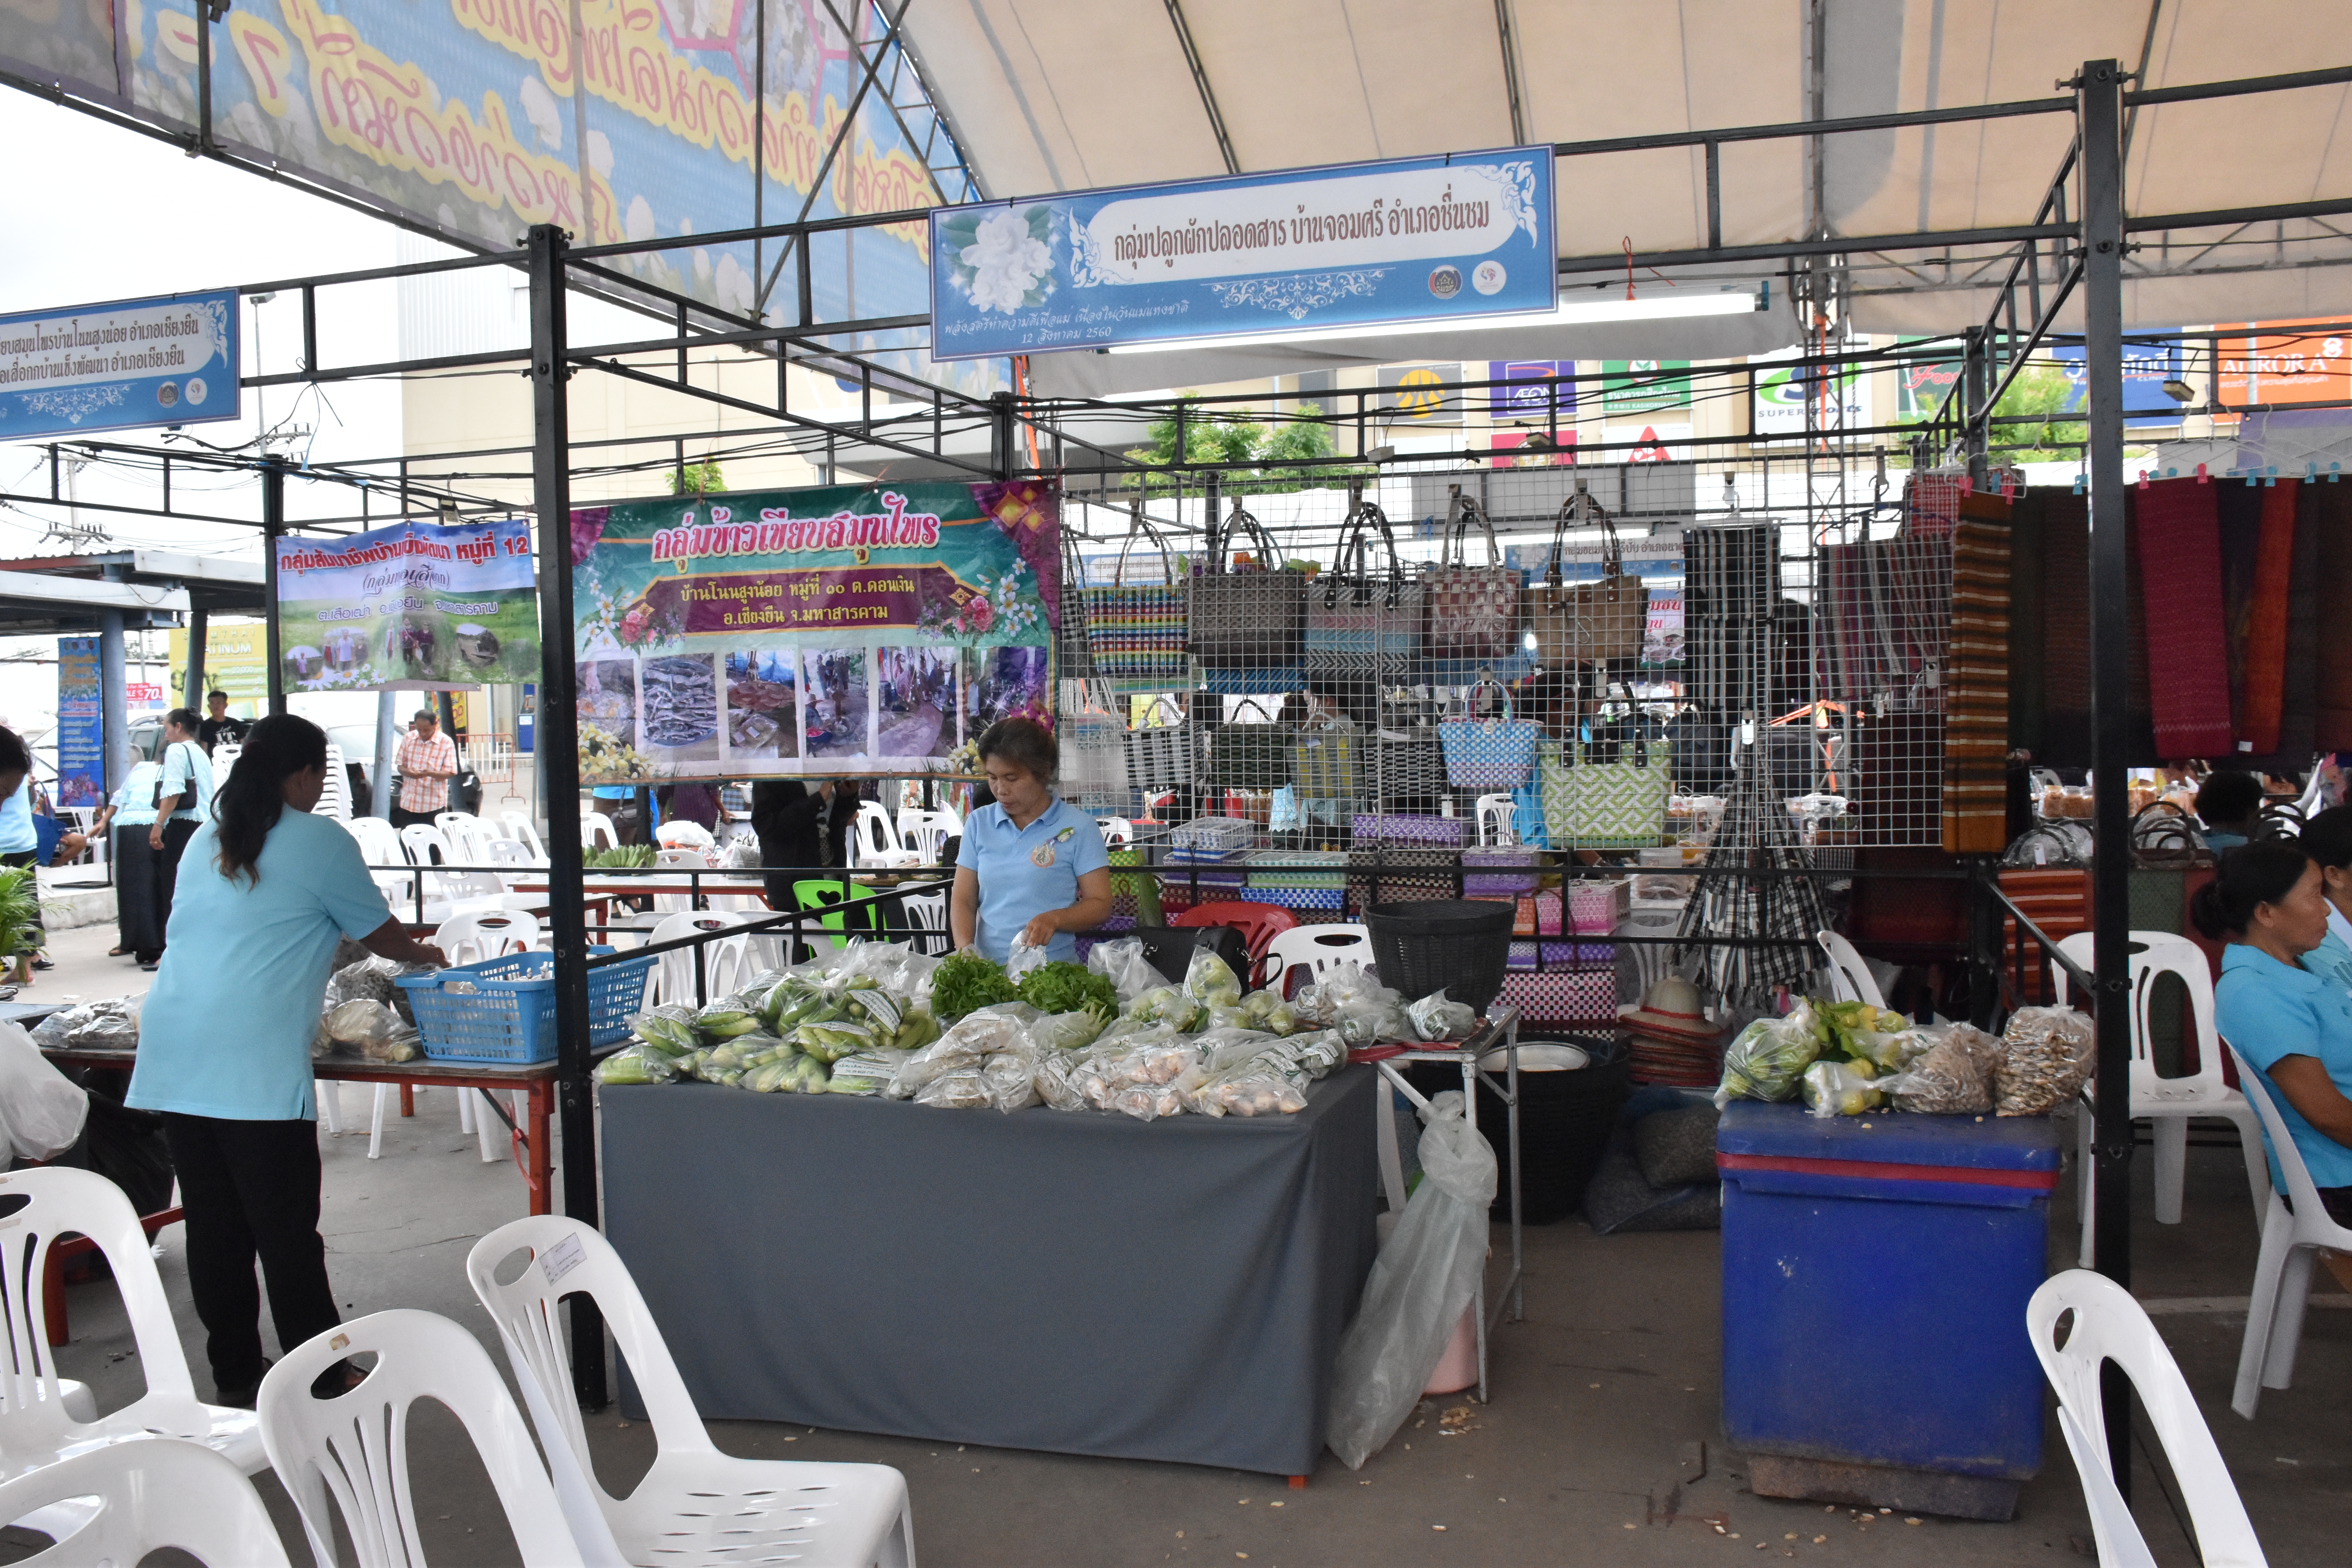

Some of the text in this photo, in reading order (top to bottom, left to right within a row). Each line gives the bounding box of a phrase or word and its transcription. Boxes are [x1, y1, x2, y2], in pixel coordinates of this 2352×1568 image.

[1114, 183, 1489, 270] กลุ่มปลูกผักปลอดสาร บ้านจอมศรี อำเภอชื่นชม
[0, 314, 199, 358] ยบสมุนไพรบ้านโนนสูงน้อย อำเภอเชียงยืน
[1022, 327, 1112, 344] 12 สิงหาคม 2560
[111, 344, 185, 371] อำเภอเชียงยืน
[1903, 364, 1958, 389] Foo
[653, 492, 940, 572] กลุ่มข้าวเขียบสมุนไพร
[456, 530, 497, 566] หมู่ที่
[504, 536, 529, 555] 12
[681, 574, 915, 604] บ้านโนนสูงน้อย หมู่ที่ ๑๐ ต.ดอนเงิน
[723, 605, 888, 625] อ.เชียงยืน จ.มหาสารคาม
[205, 642, 252, 655] ATINUM
